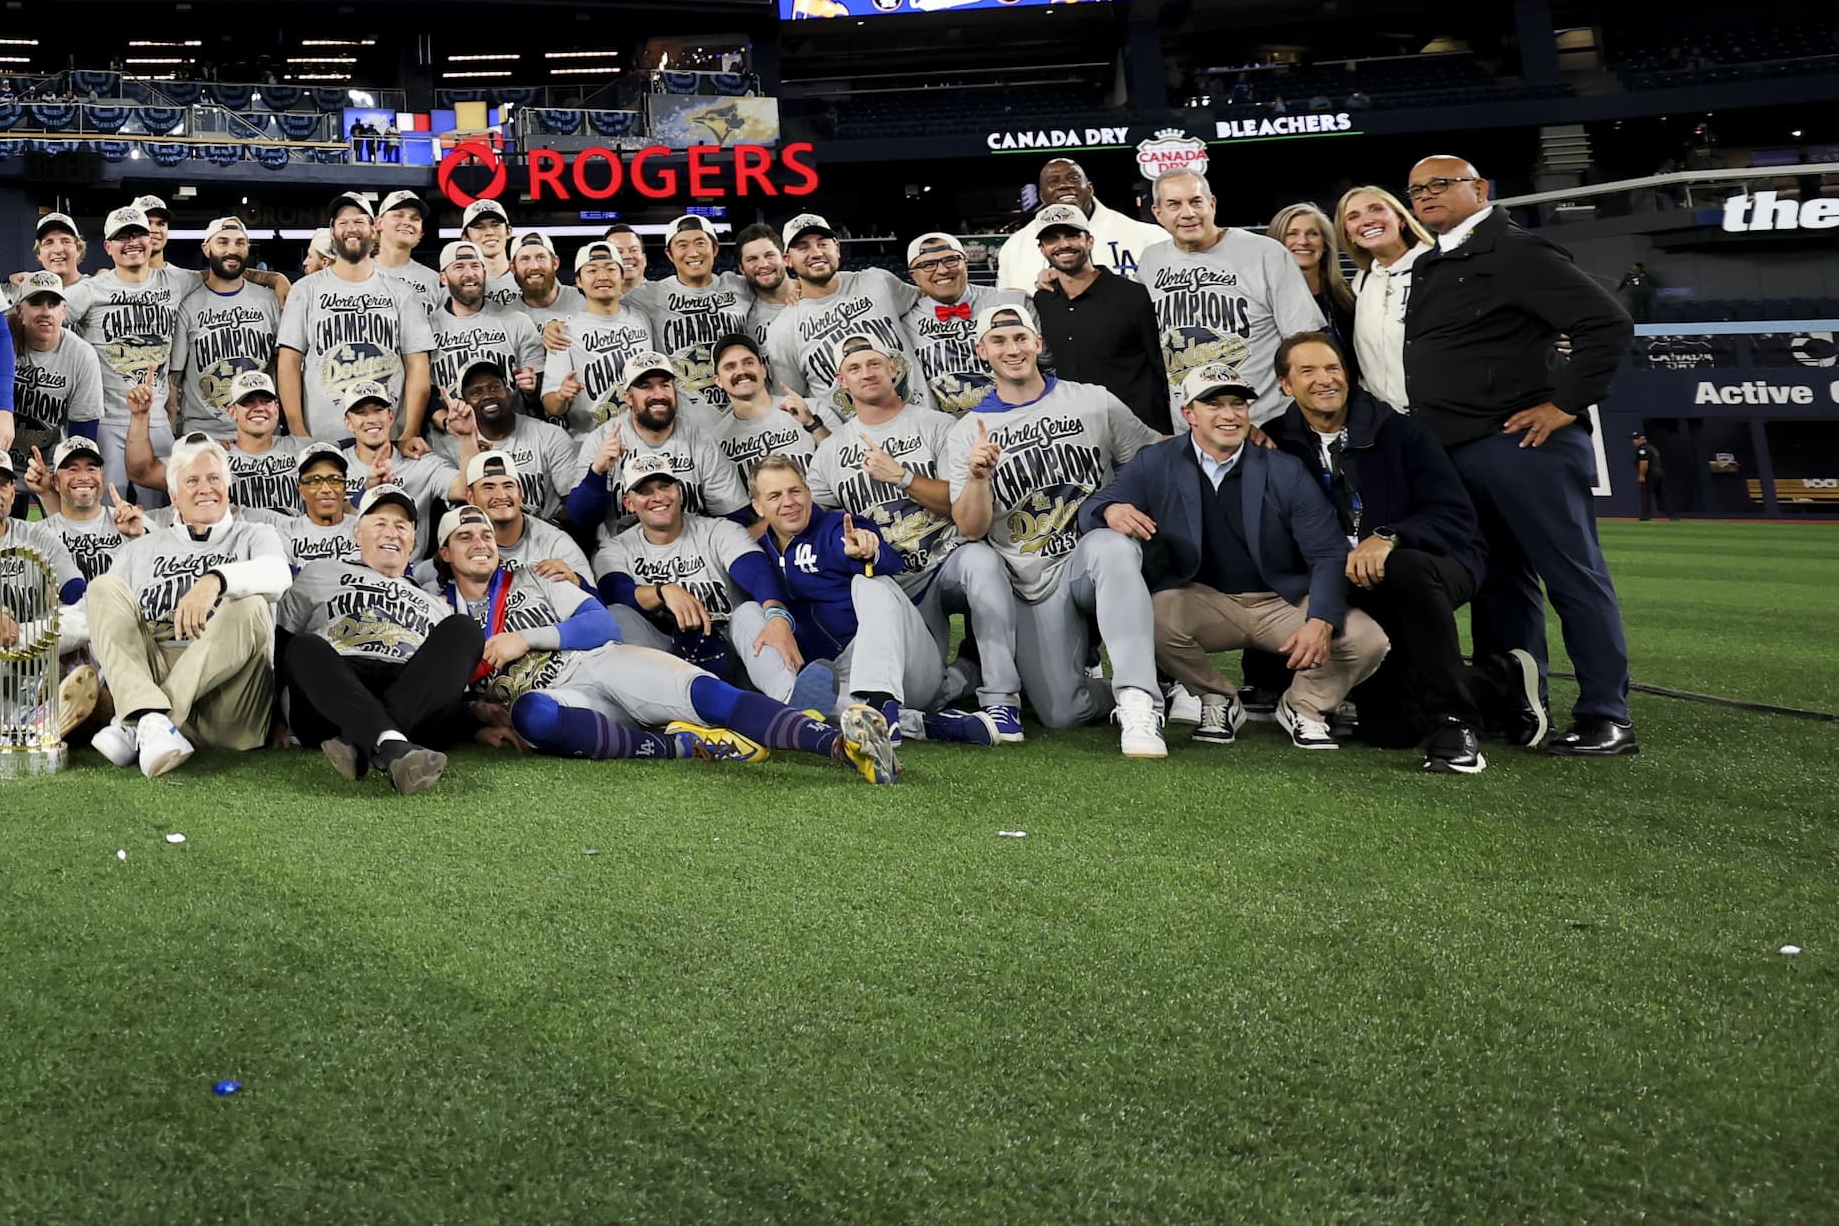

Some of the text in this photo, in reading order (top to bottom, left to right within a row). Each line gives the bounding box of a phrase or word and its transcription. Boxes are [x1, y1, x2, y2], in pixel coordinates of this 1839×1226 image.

[987, 127, 1129, 149] CANADA DRY
[1216, 113, 1352, 139] BLEACHERS
[1138, 149, 1209, 163] CANADA
[528, 142, 820, 200] ROGERS
[1722, 190, 1839, 232] the
[800, 296, 873, 342] World Series
[434, 328, 506, 353] World Series
[1694, 380, 1814, 405] Active
[721, 429, 799, 458] World Series
[1037, 416, 1084, 448] Series
[993, 444, 1104, 510] CHAMPIONS
[793, 542, 818, 574] LA
[1041, 535, 1077, 558] 2025
